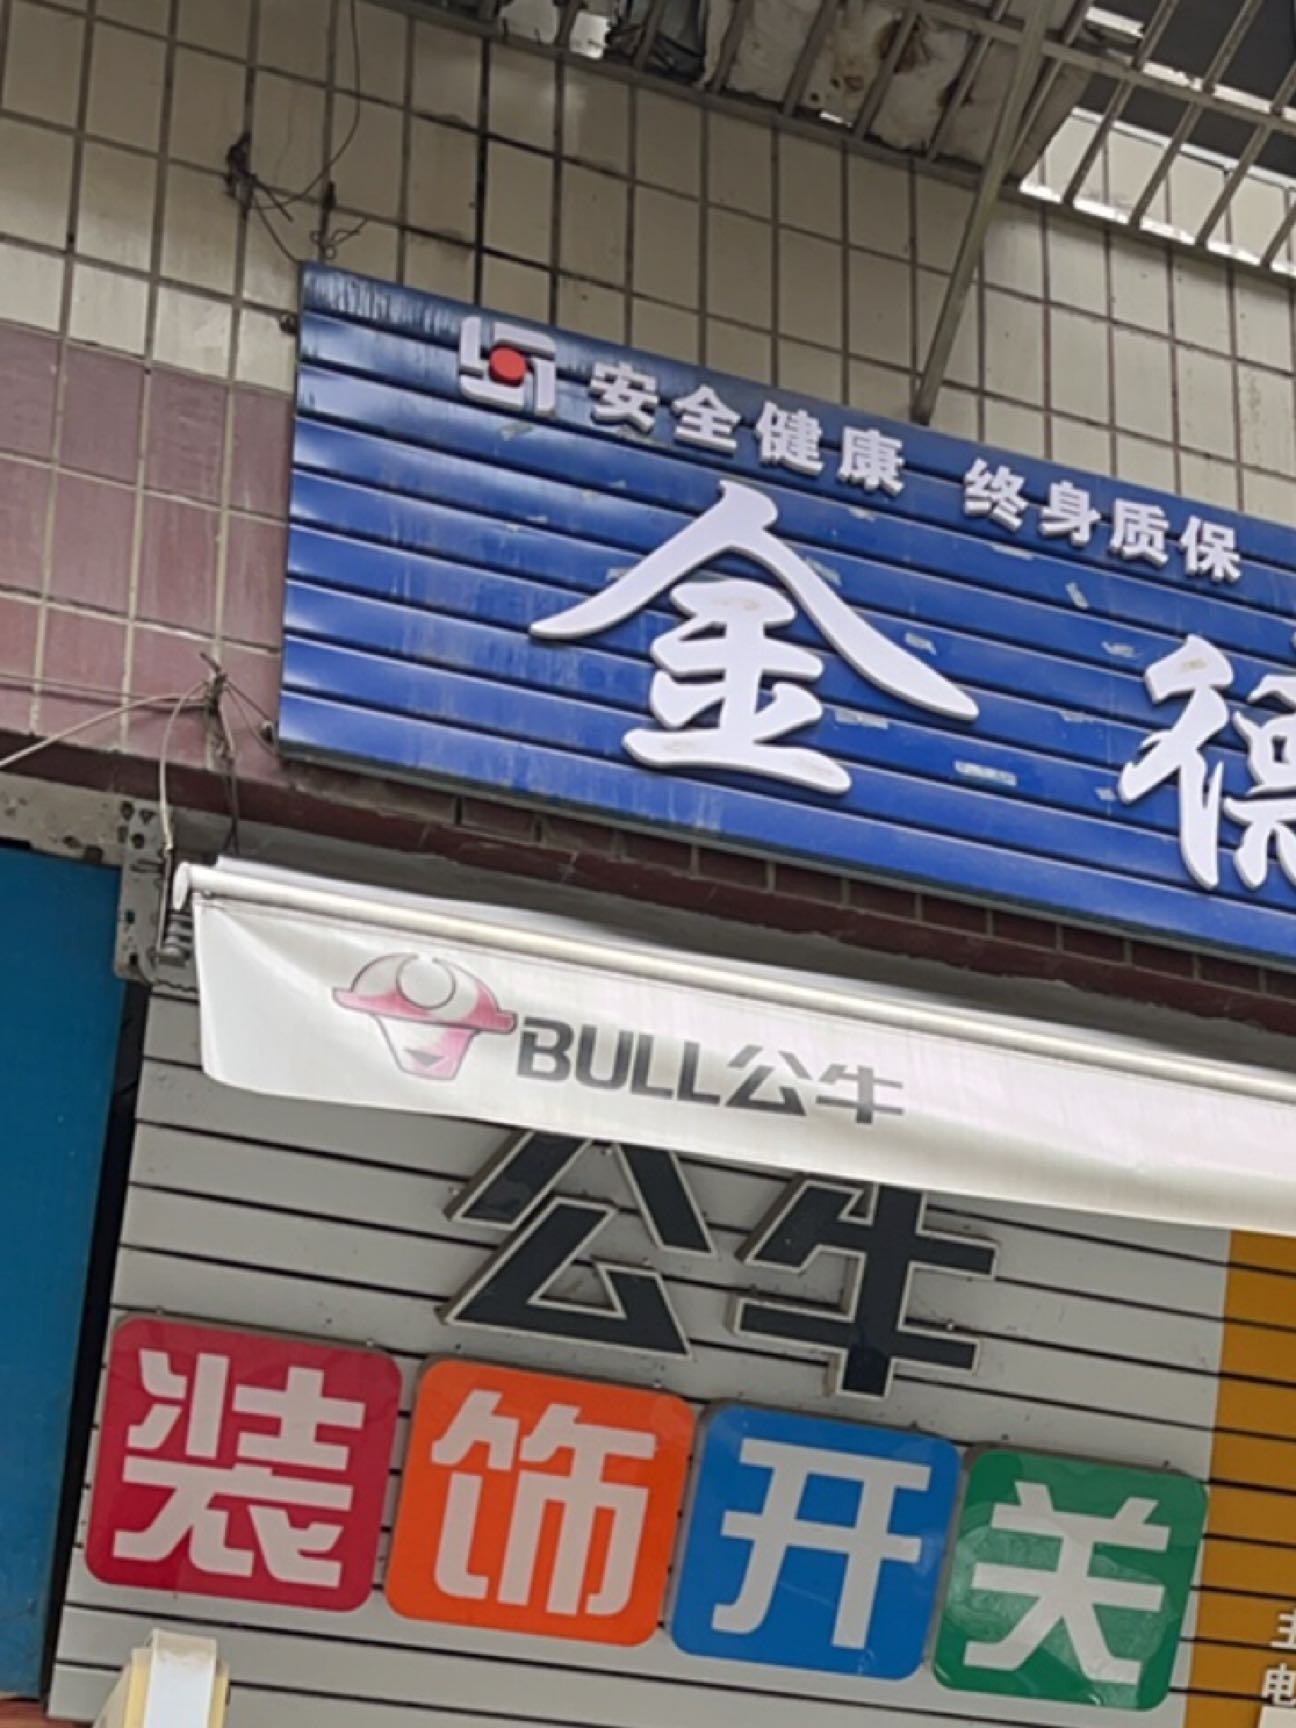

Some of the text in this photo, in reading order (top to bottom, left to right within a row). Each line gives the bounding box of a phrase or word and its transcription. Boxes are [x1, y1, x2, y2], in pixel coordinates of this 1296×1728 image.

[587, 361, 1240, 583] 安全健康 终身质保
[444, 1128, 997, 1397] 公牛
[113, 1349, 1172, 1685] 装饰开关
